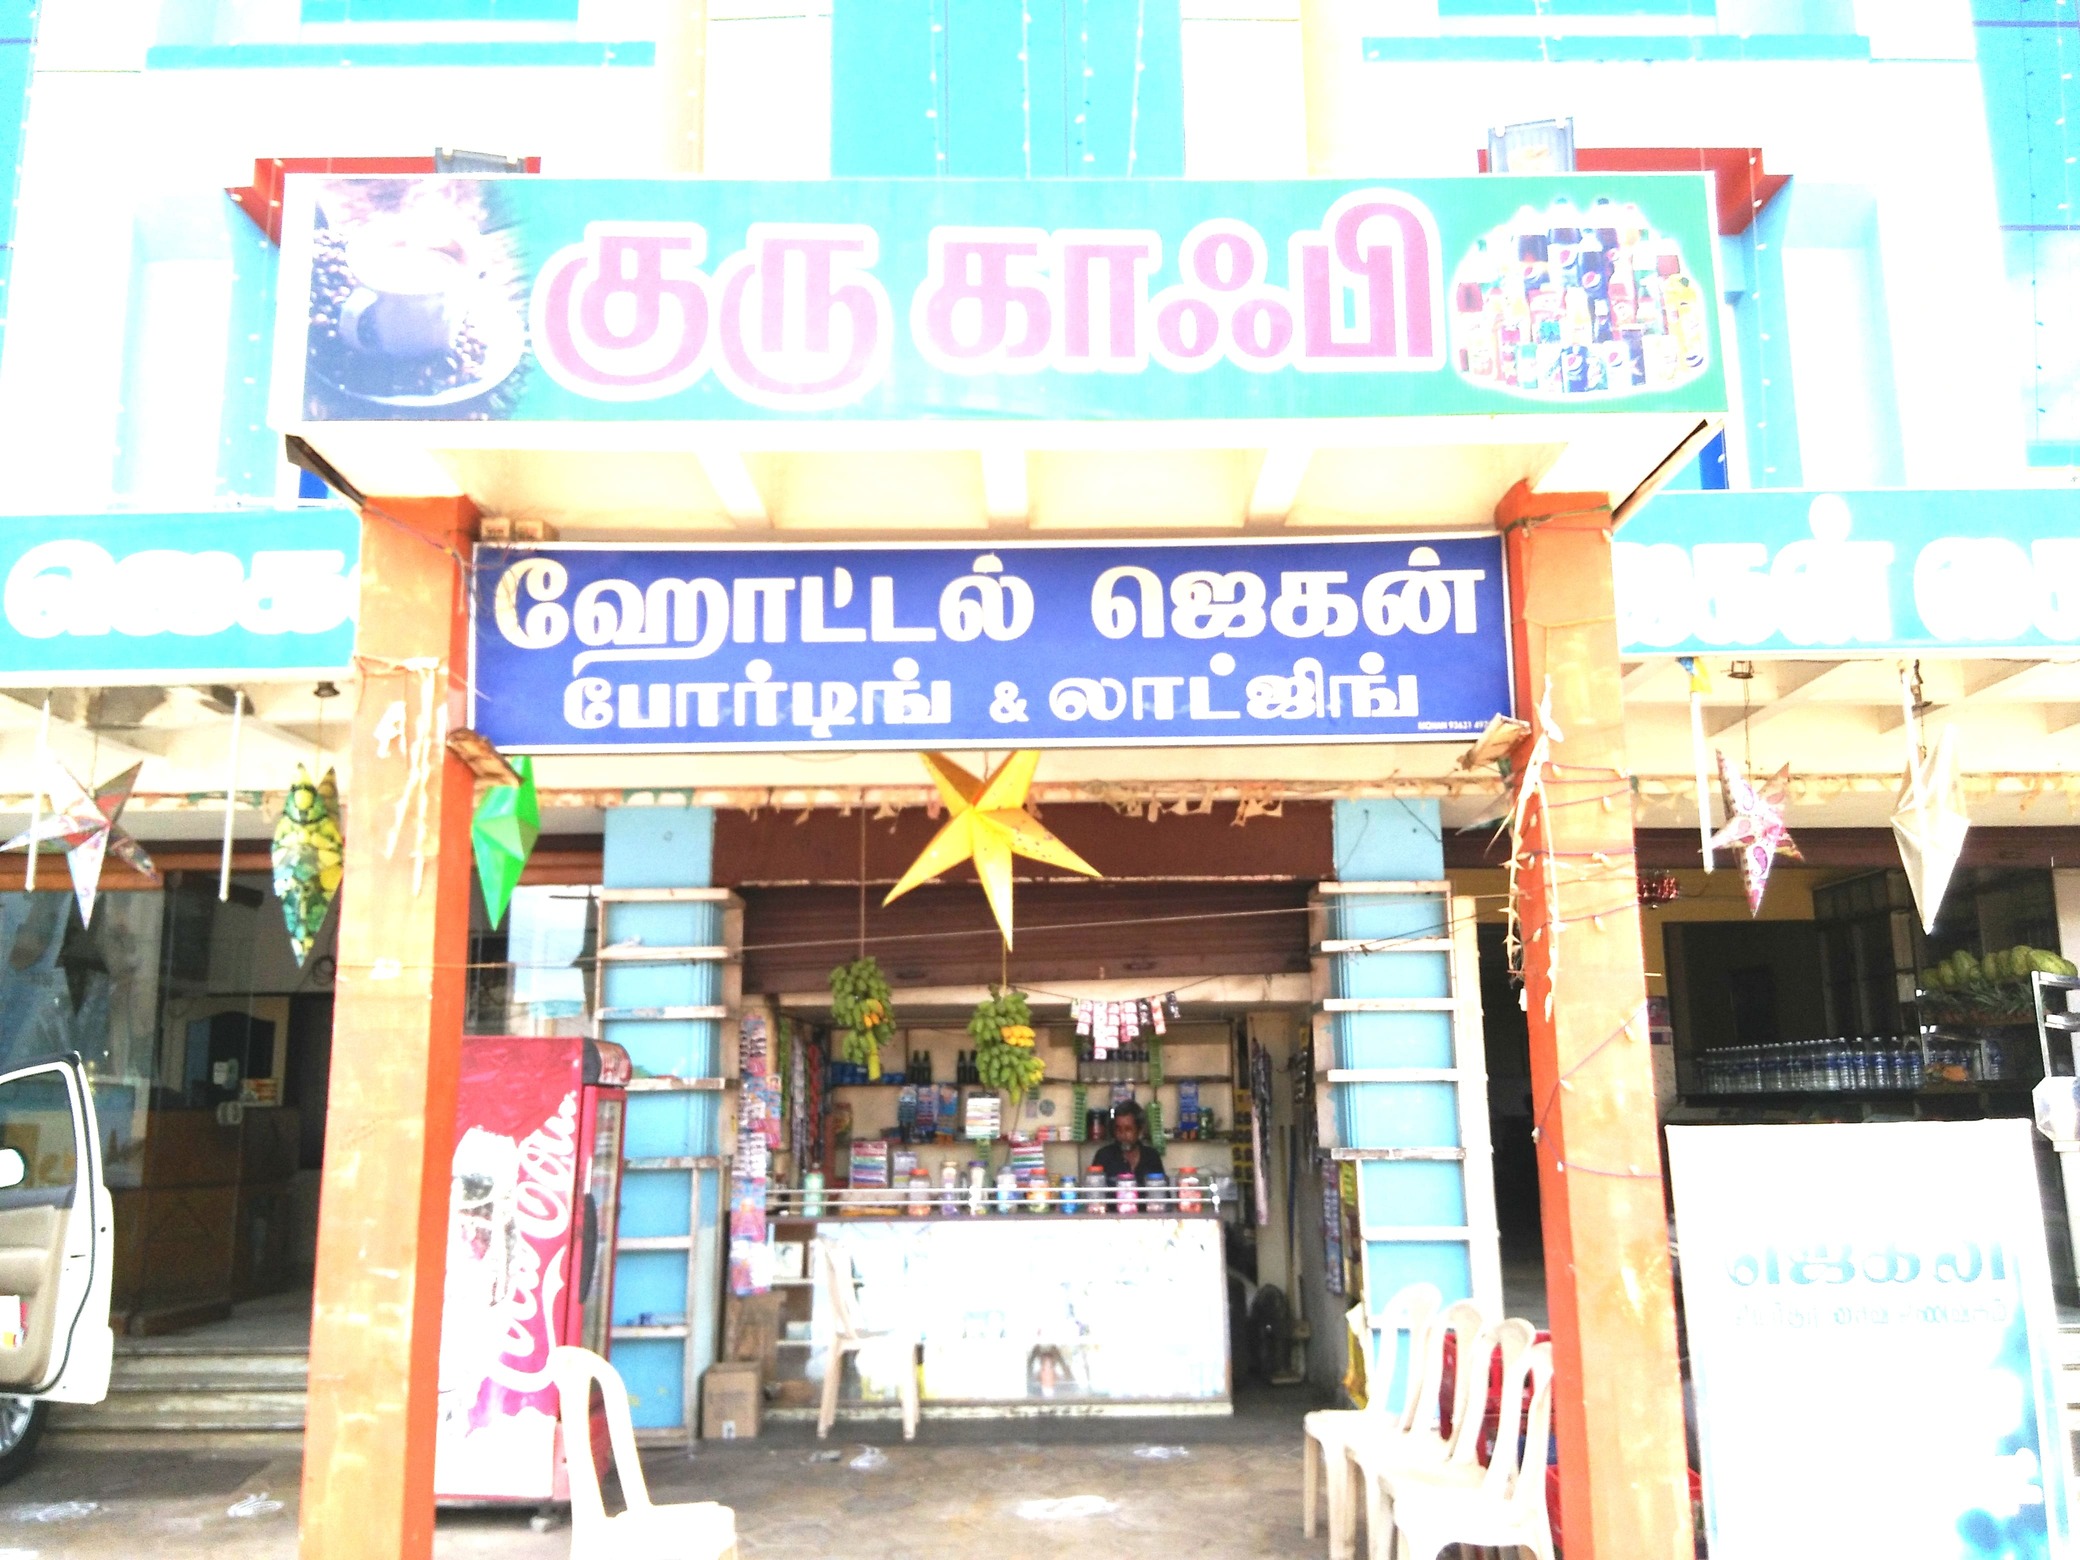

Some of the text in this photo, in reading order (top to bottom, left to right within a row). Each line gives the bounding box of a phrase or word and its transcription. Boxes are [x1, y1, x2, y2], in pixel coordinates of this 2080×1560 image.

[531, 187, 1448, 411] குரு காஃபி
[495, 546, 1485, 678] ஹோட்டல் ஜெகன்
[563, 651, 1418, 736] போர்டிங் & லாட்ஜிங்
